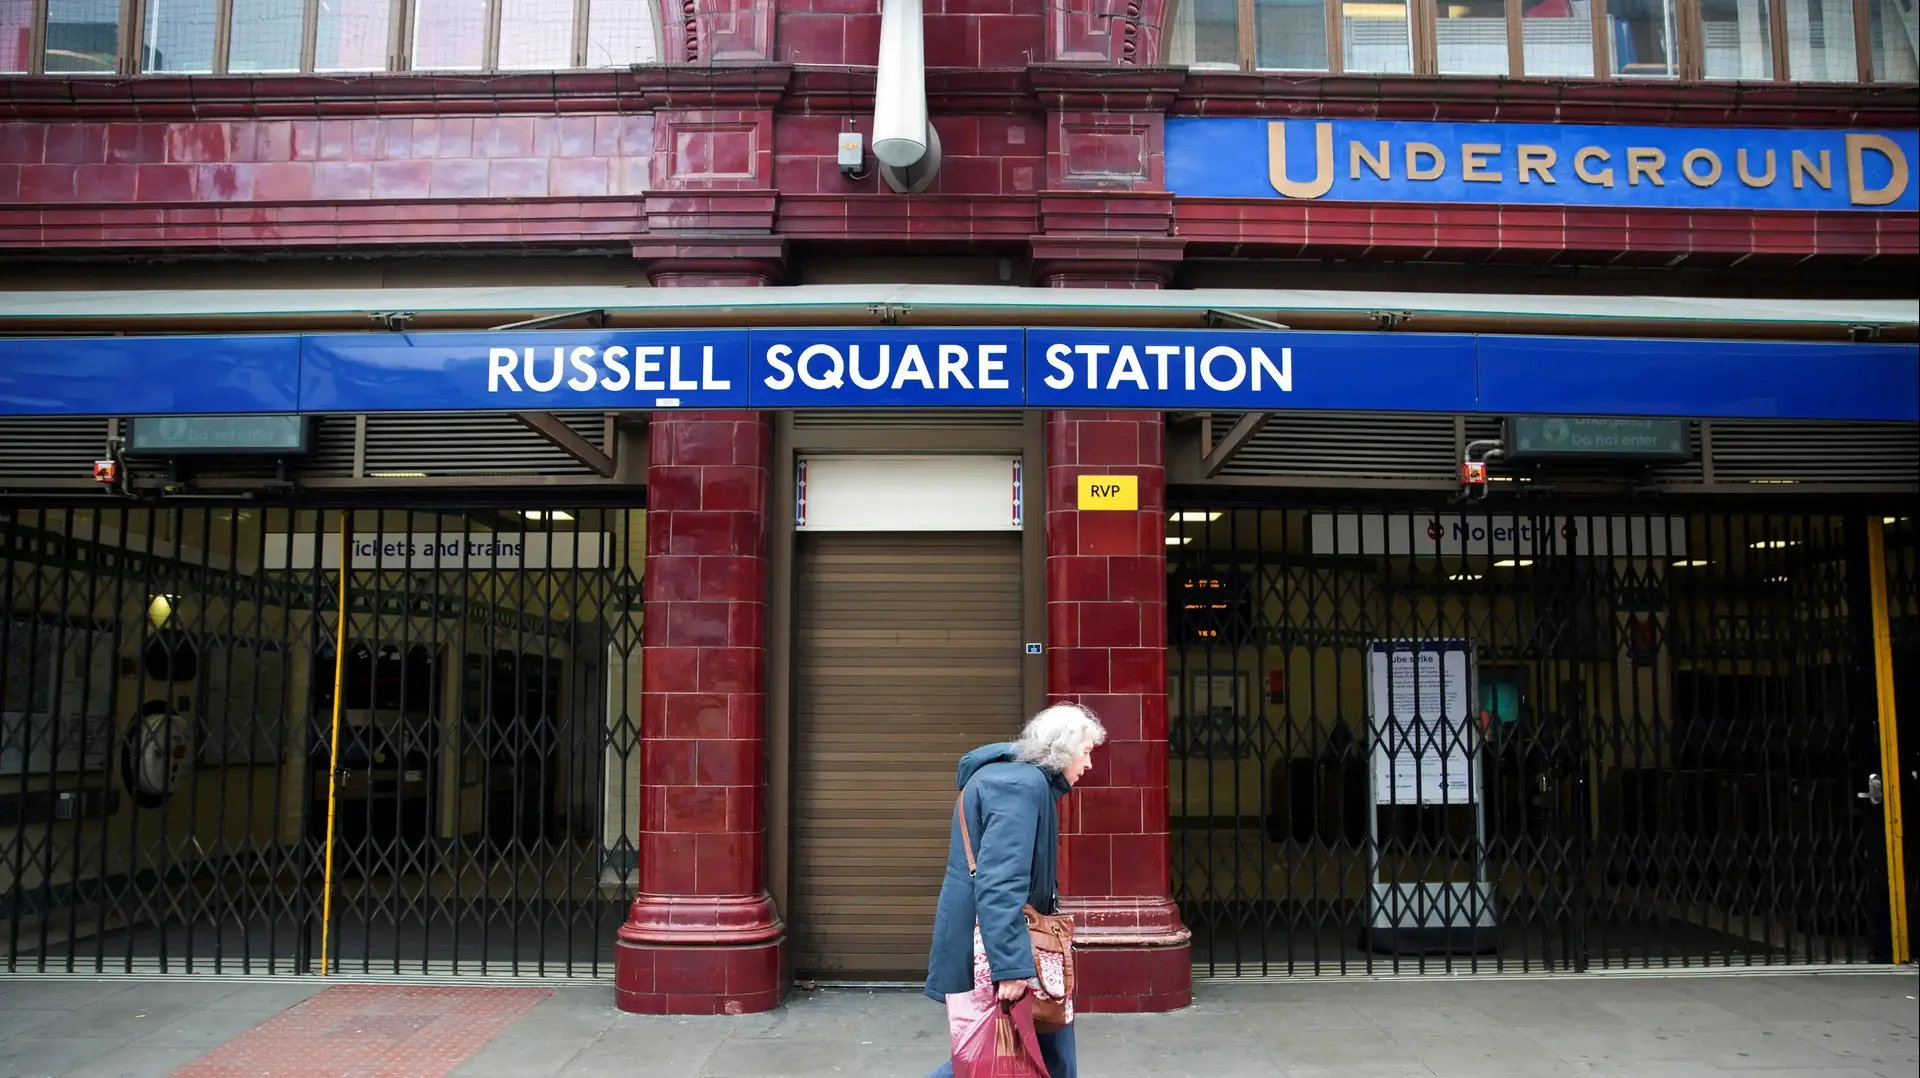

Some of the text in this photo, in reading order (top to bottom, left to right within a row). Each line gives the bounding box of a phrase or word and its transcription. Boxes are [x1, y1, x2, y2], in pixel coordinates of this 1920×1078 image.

[1267, 121, 1909, 207] UNDERGROUND
[488, 343, 1293, 392] RUSSELL SQUARE STATION
[1572, 434, 1592, 446] Do
[1091, 485, 1120, 497] RVP
[1453, 522, 1485, 541] No
[423, 540, 459, 557] and
[468, 540, 522, 557] trains
